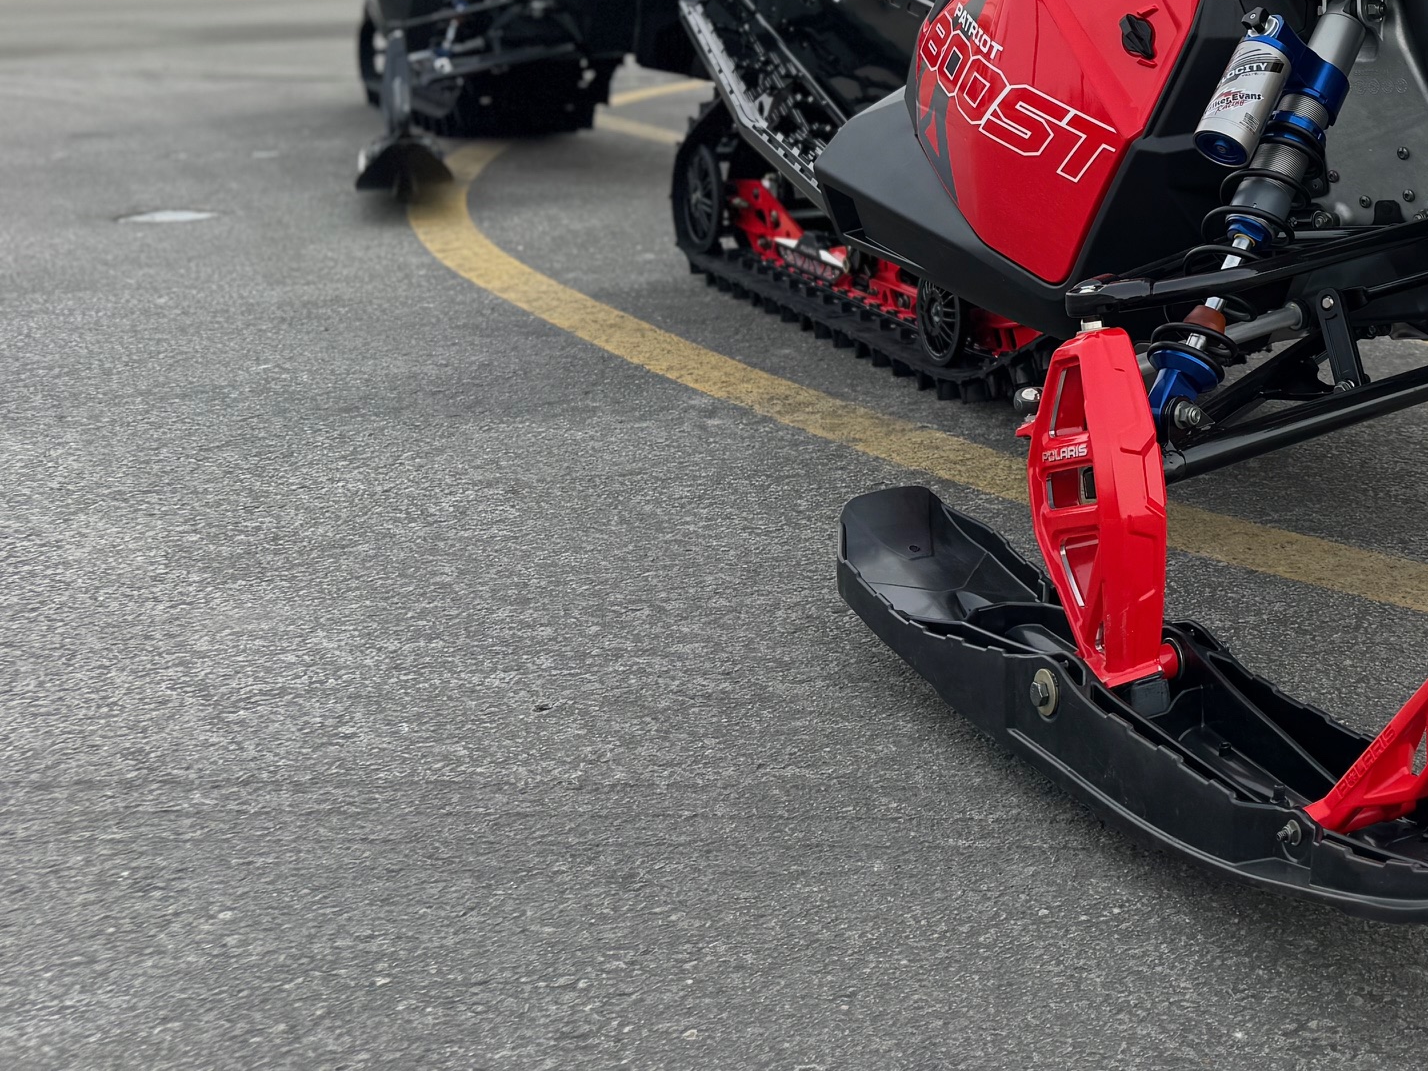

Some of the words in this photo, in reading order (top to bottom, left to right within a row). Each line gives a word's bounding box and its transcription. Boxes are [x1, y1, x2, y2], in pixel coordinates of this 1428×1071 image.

[953, 2, 1003, 60] PATRIOT
[920, 11, 1117, 183] BOOST
[1231, 92, 1262, 101] Evans
[1042, 442, 1089, 463] POLARIS
[1336, 726, 1397, 799] POLARIS
